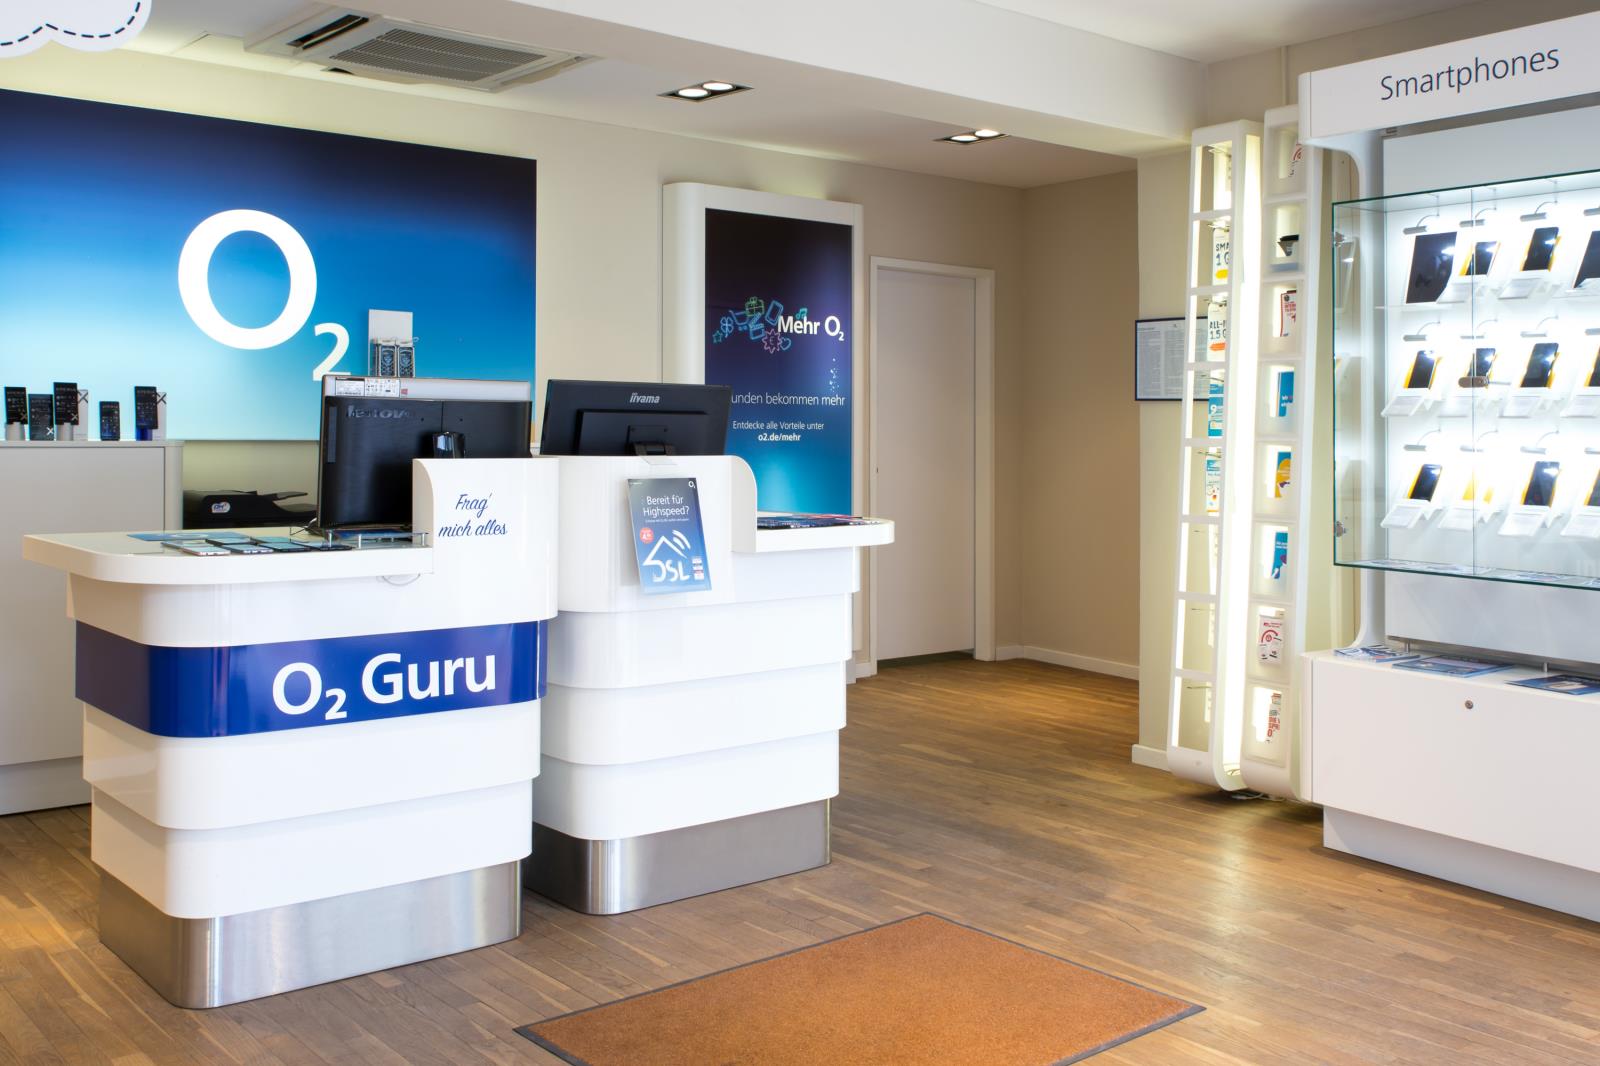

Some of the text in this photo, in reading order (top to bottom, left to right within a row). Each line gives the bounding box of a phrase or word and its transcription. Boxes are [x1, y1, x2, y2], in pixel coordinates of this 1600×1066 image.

[1381, 49, 1560, 100] Smartphones
[178, 209, 351, 381] O2
[778, 315, 845, 341] Mehr O2
[630, 392, 660, 404] iiyama
[731, 392, 845, 406] unden bekommen mehr
[732, 420, 824, 430] Entdecke alle Vorteile unter
[758, 433, 801, 442] o2.de/mehr
[646, 494, 684, 505] Bereit für
[643, 505, 690, 518] Highspeed?
[438, 519, 508, 537] mich alles
[644, 560, 691, 582] DSL
[272, 653, 496, 720] O2 Guru
